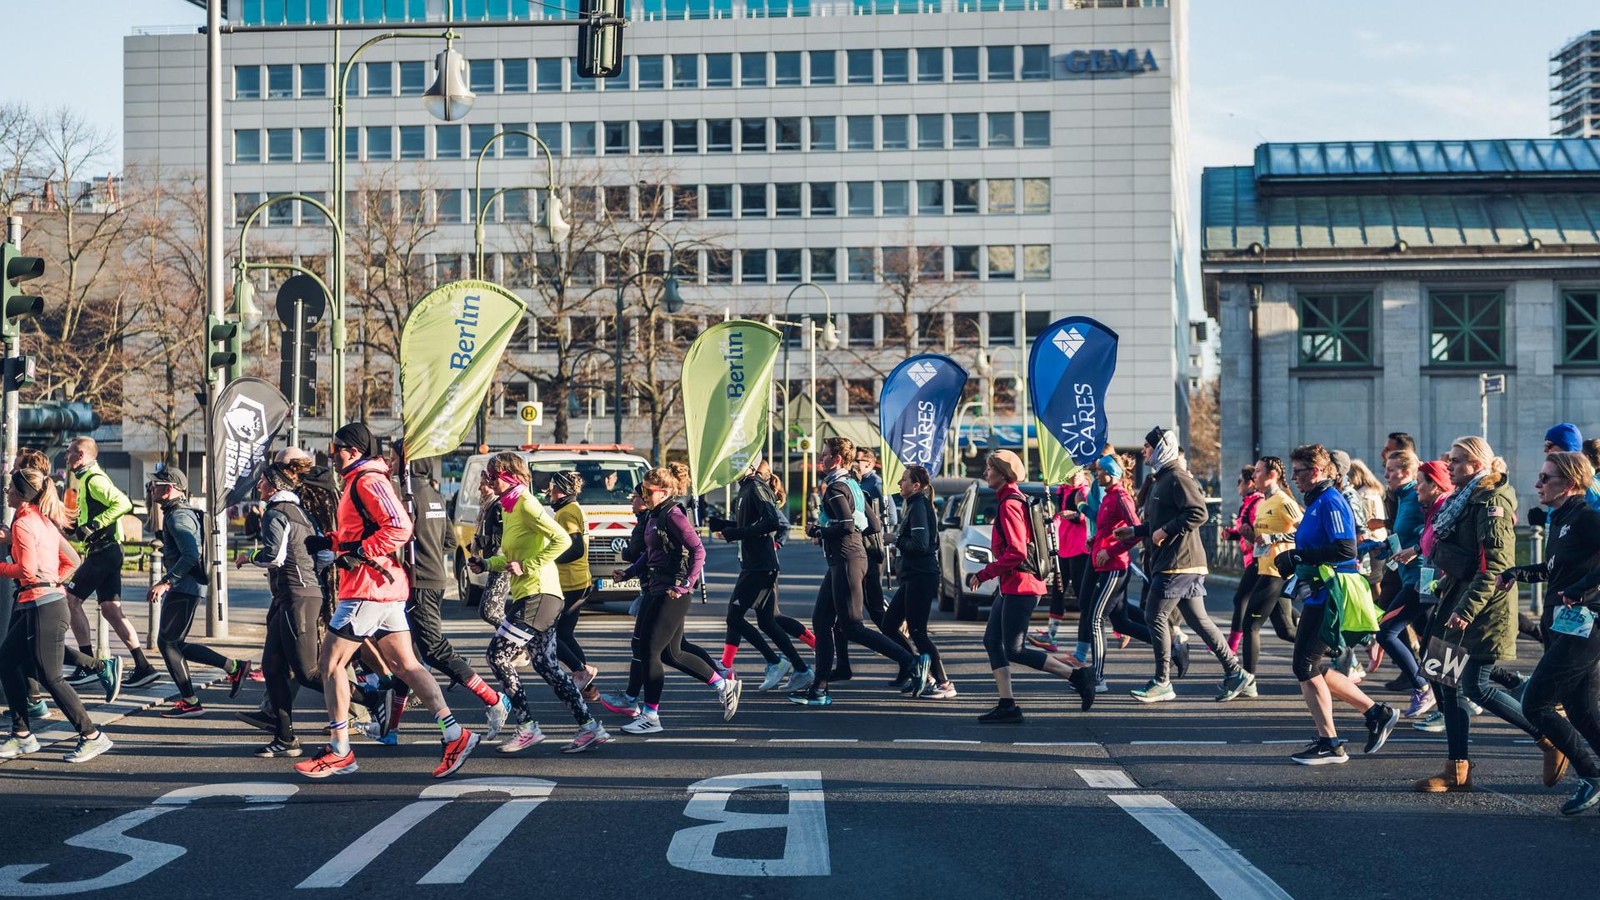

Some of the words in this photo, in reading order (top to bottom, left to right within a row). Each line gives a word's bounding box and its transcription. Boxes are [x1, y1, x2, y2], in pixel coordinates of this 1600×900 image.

[1065, 48, 1159, 73] GEMA
[450, 294, 481, 370] Berlin
[725, 331, 745, 400] Berlin
[903, 427, 917, 465] KVL
[918, 400, 934, 464] CARES
[1061, 415, 1079, 458] KVL
[1074, 383, 1096, 456] CARES
[224, 437, 240, 490] BERLIN
[0, 770, 832, 897] BUS
